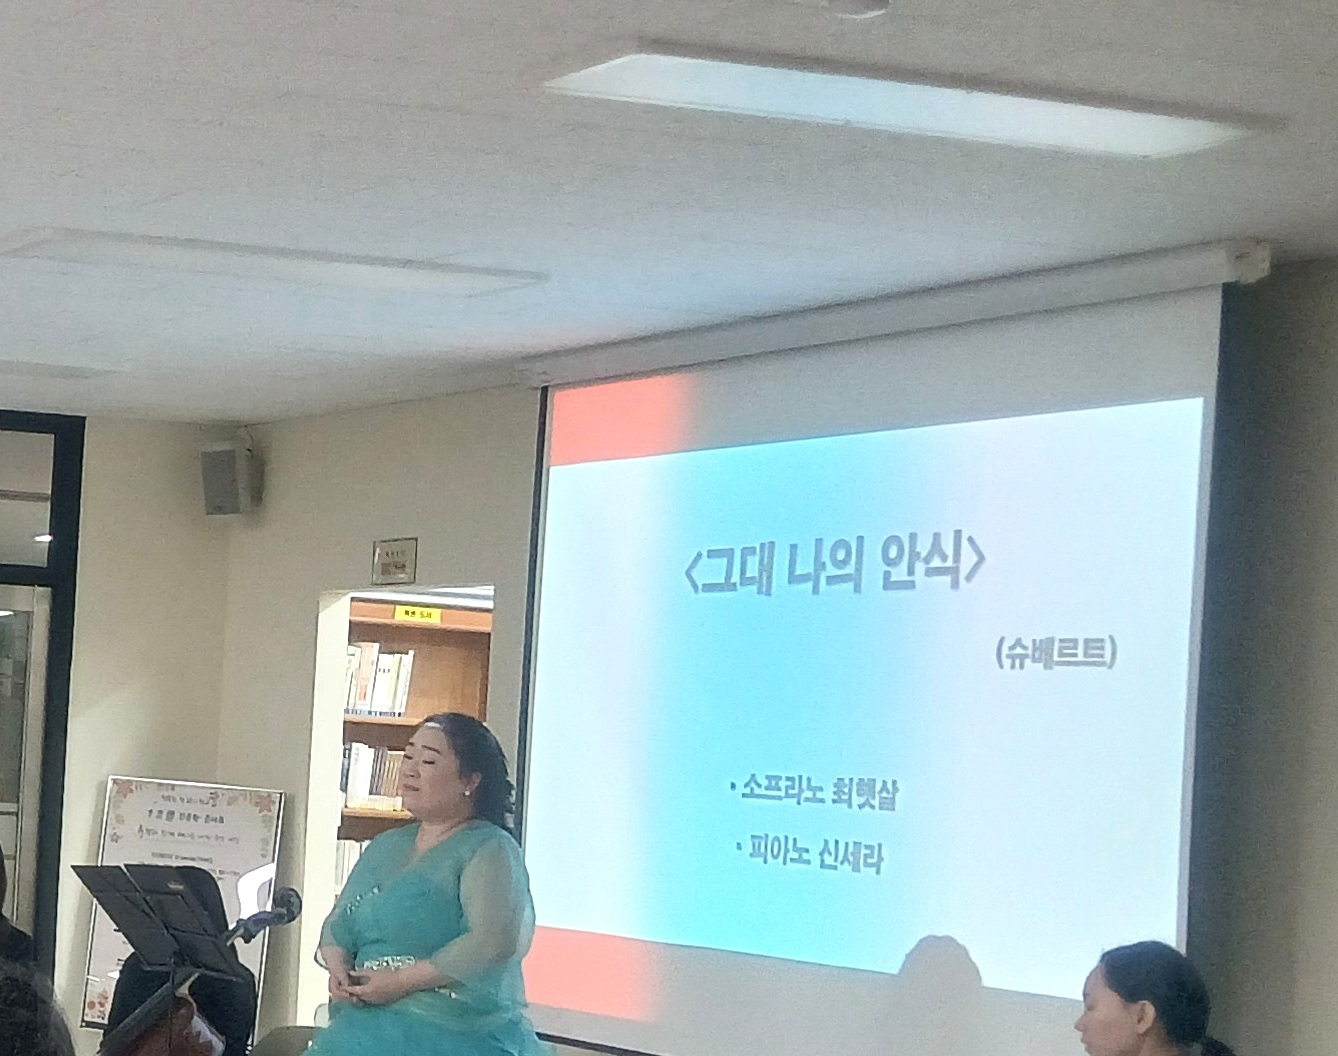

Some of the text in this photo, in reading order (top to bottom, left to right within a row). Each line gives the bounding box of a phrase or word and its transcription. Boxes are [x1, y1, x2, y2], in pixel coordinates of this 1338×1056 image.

[787, 535, 864, 595] 나의
[996, 634, 1118, 671] (슈베르트)
[741, 773, 826, 805] 소프라노
[749, 833, 885, 875] 피아노 신세라
